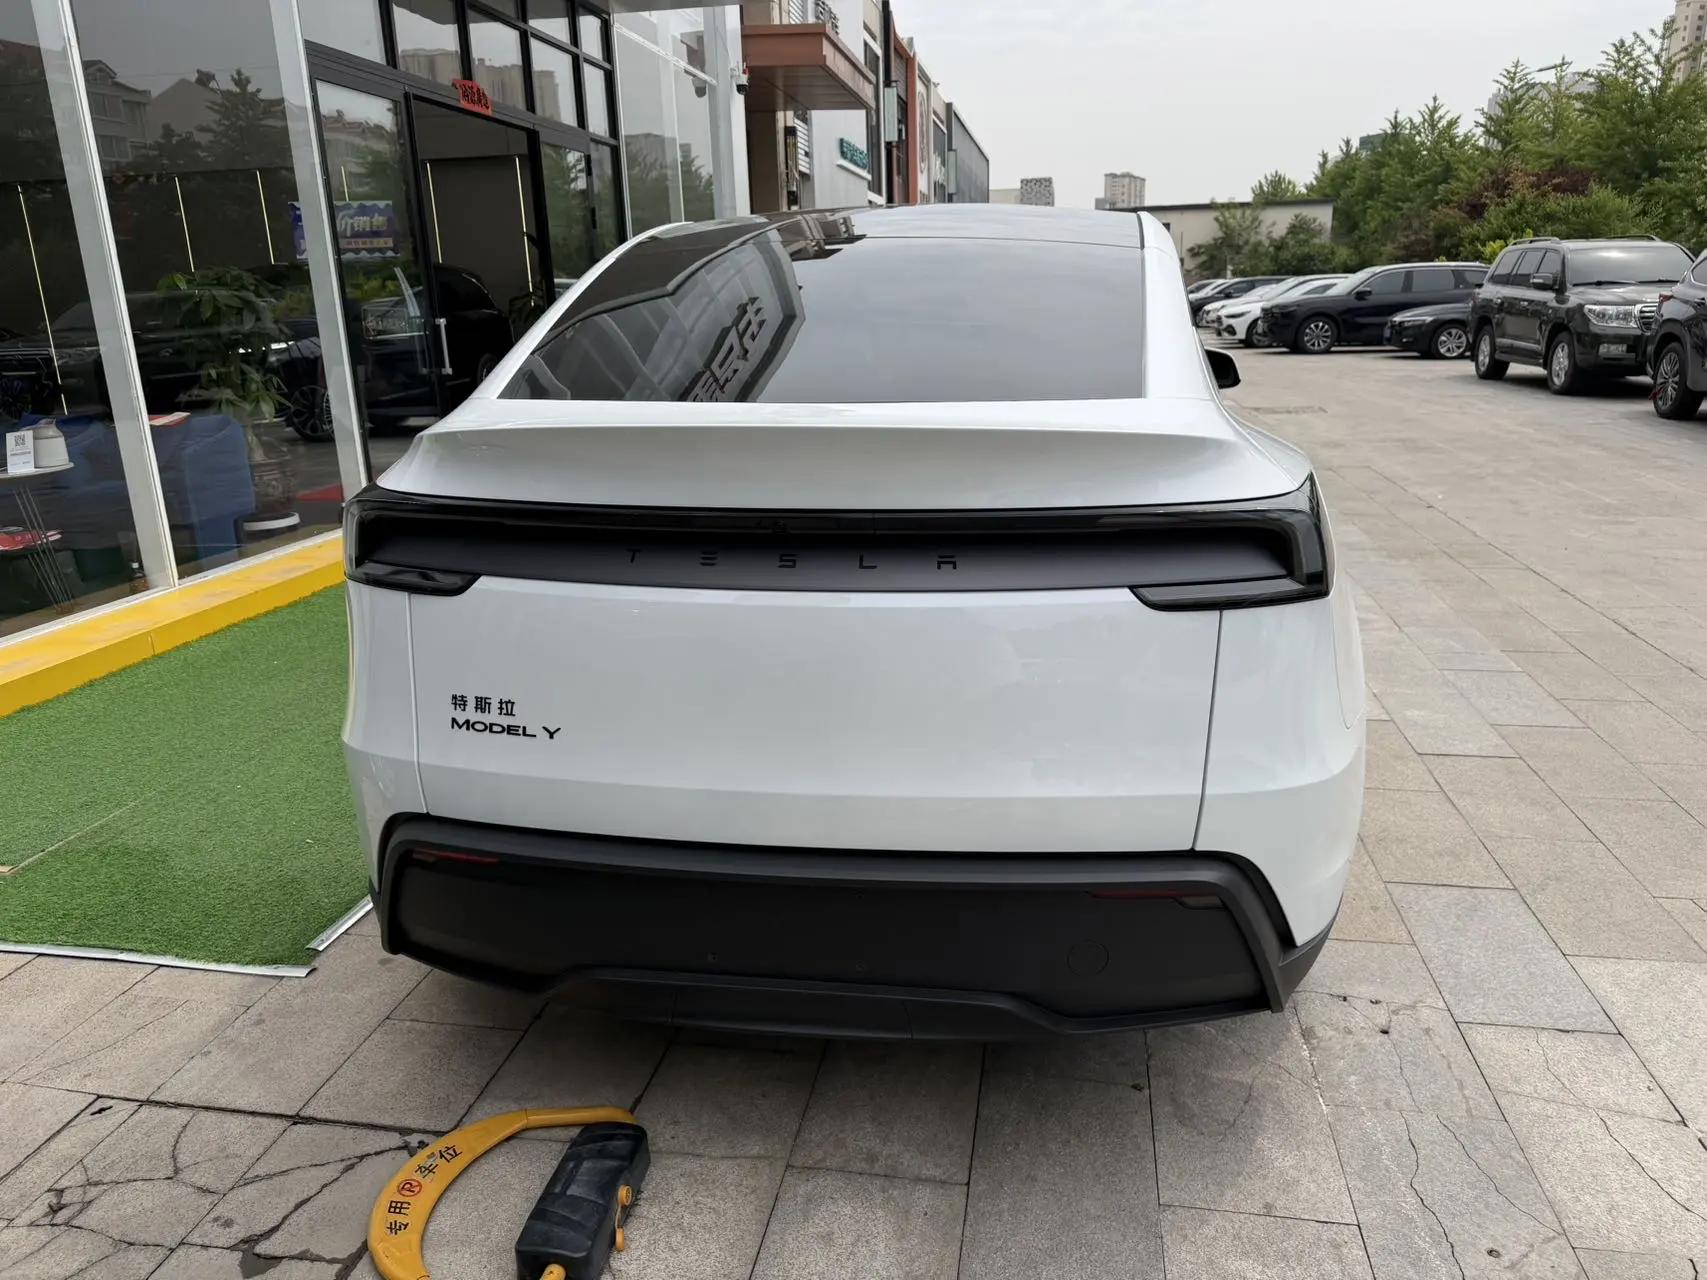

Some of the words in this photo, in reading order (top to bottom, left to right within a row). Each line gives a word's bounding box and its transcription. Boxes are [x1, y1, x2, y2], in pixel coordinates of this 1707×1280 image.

[627, 549, 957, 570] TESLA
[451, 694, 516, 717] 特斯拉
[451, 717, 537, 738] MODEL
[542, 726, 561, 739] Y
